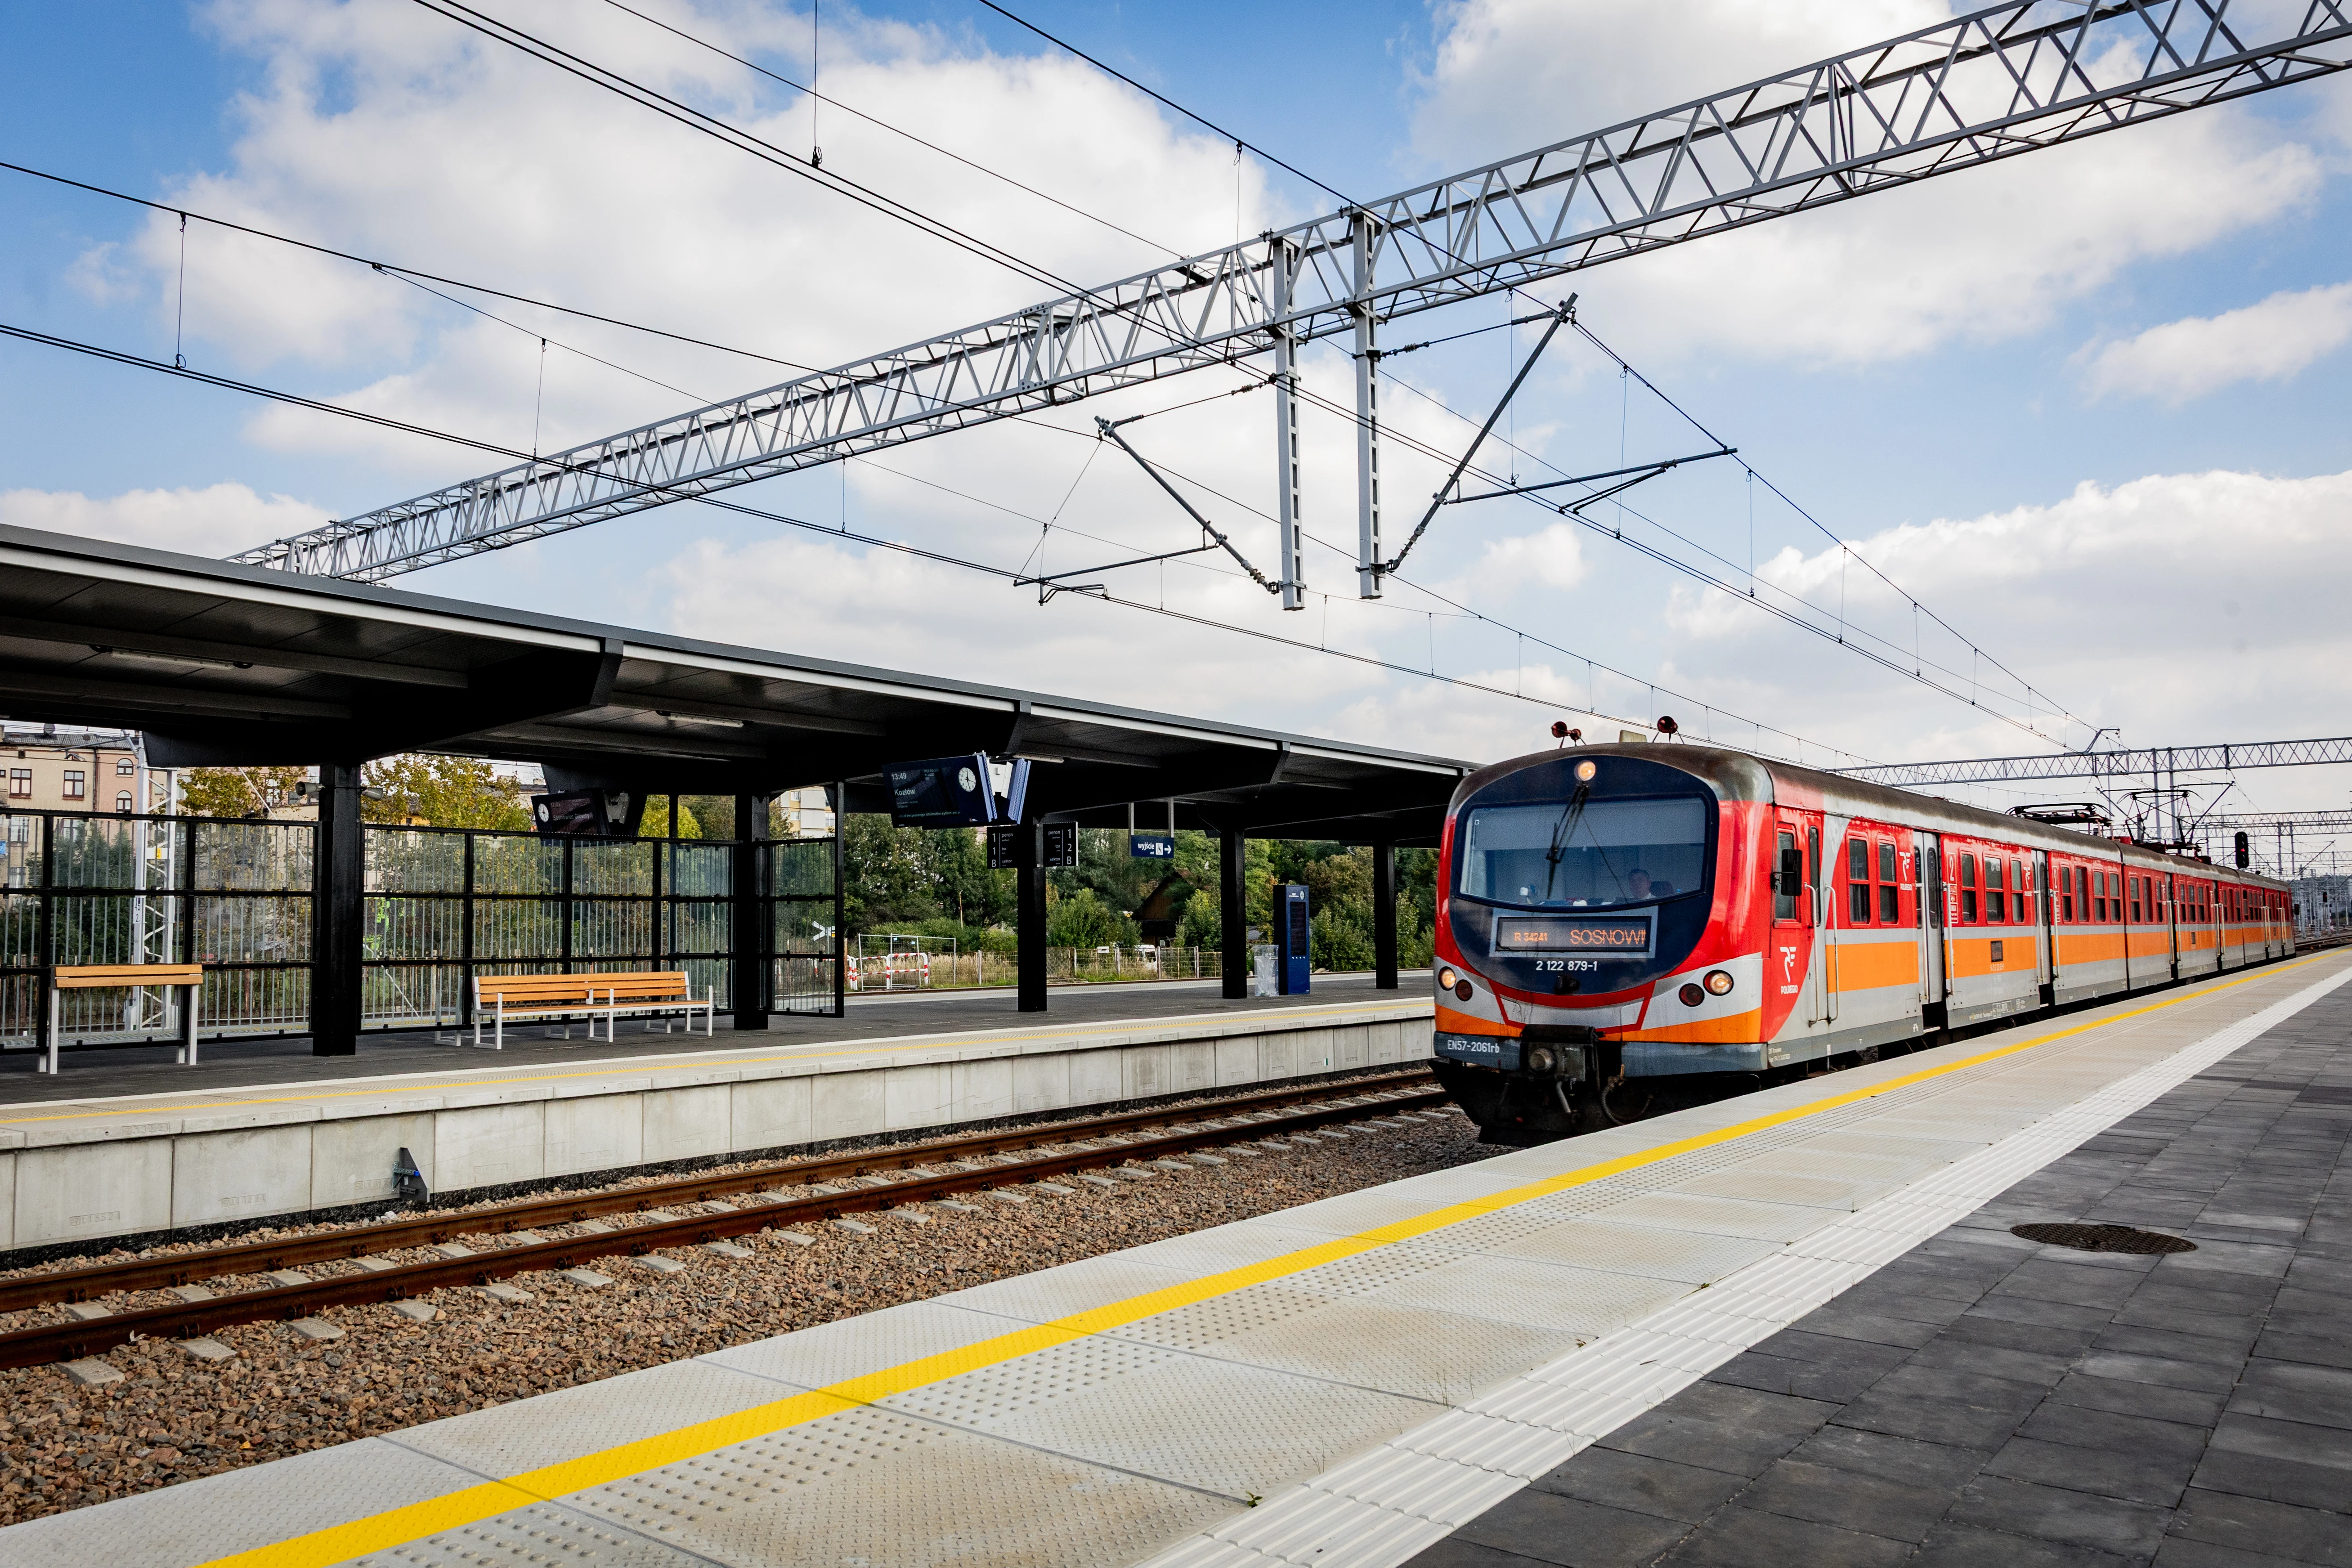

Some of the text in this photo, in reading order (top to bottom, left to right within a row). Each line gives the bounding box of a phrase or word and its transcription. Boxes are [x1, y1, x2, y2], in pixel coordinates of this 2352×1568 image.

[992, 833, 995, 842] 1
[1067, 829, 1071, 838] 1
[992, 847, 995, 855] 1
[1067, 843, 1072, 851] 2
[1138, 842, 1155, 851] wyjście
[992, 859, 996, 868] B
[1066, 856, 1072, 865] B
[1949, 856, 1954, 881] 2
[1514, 932, 1547, 942] R 34241
[1536, 961, 1597, 971] 2 122 879-1
[1447, 1039, 1500, 1053] EN57-2061rb
